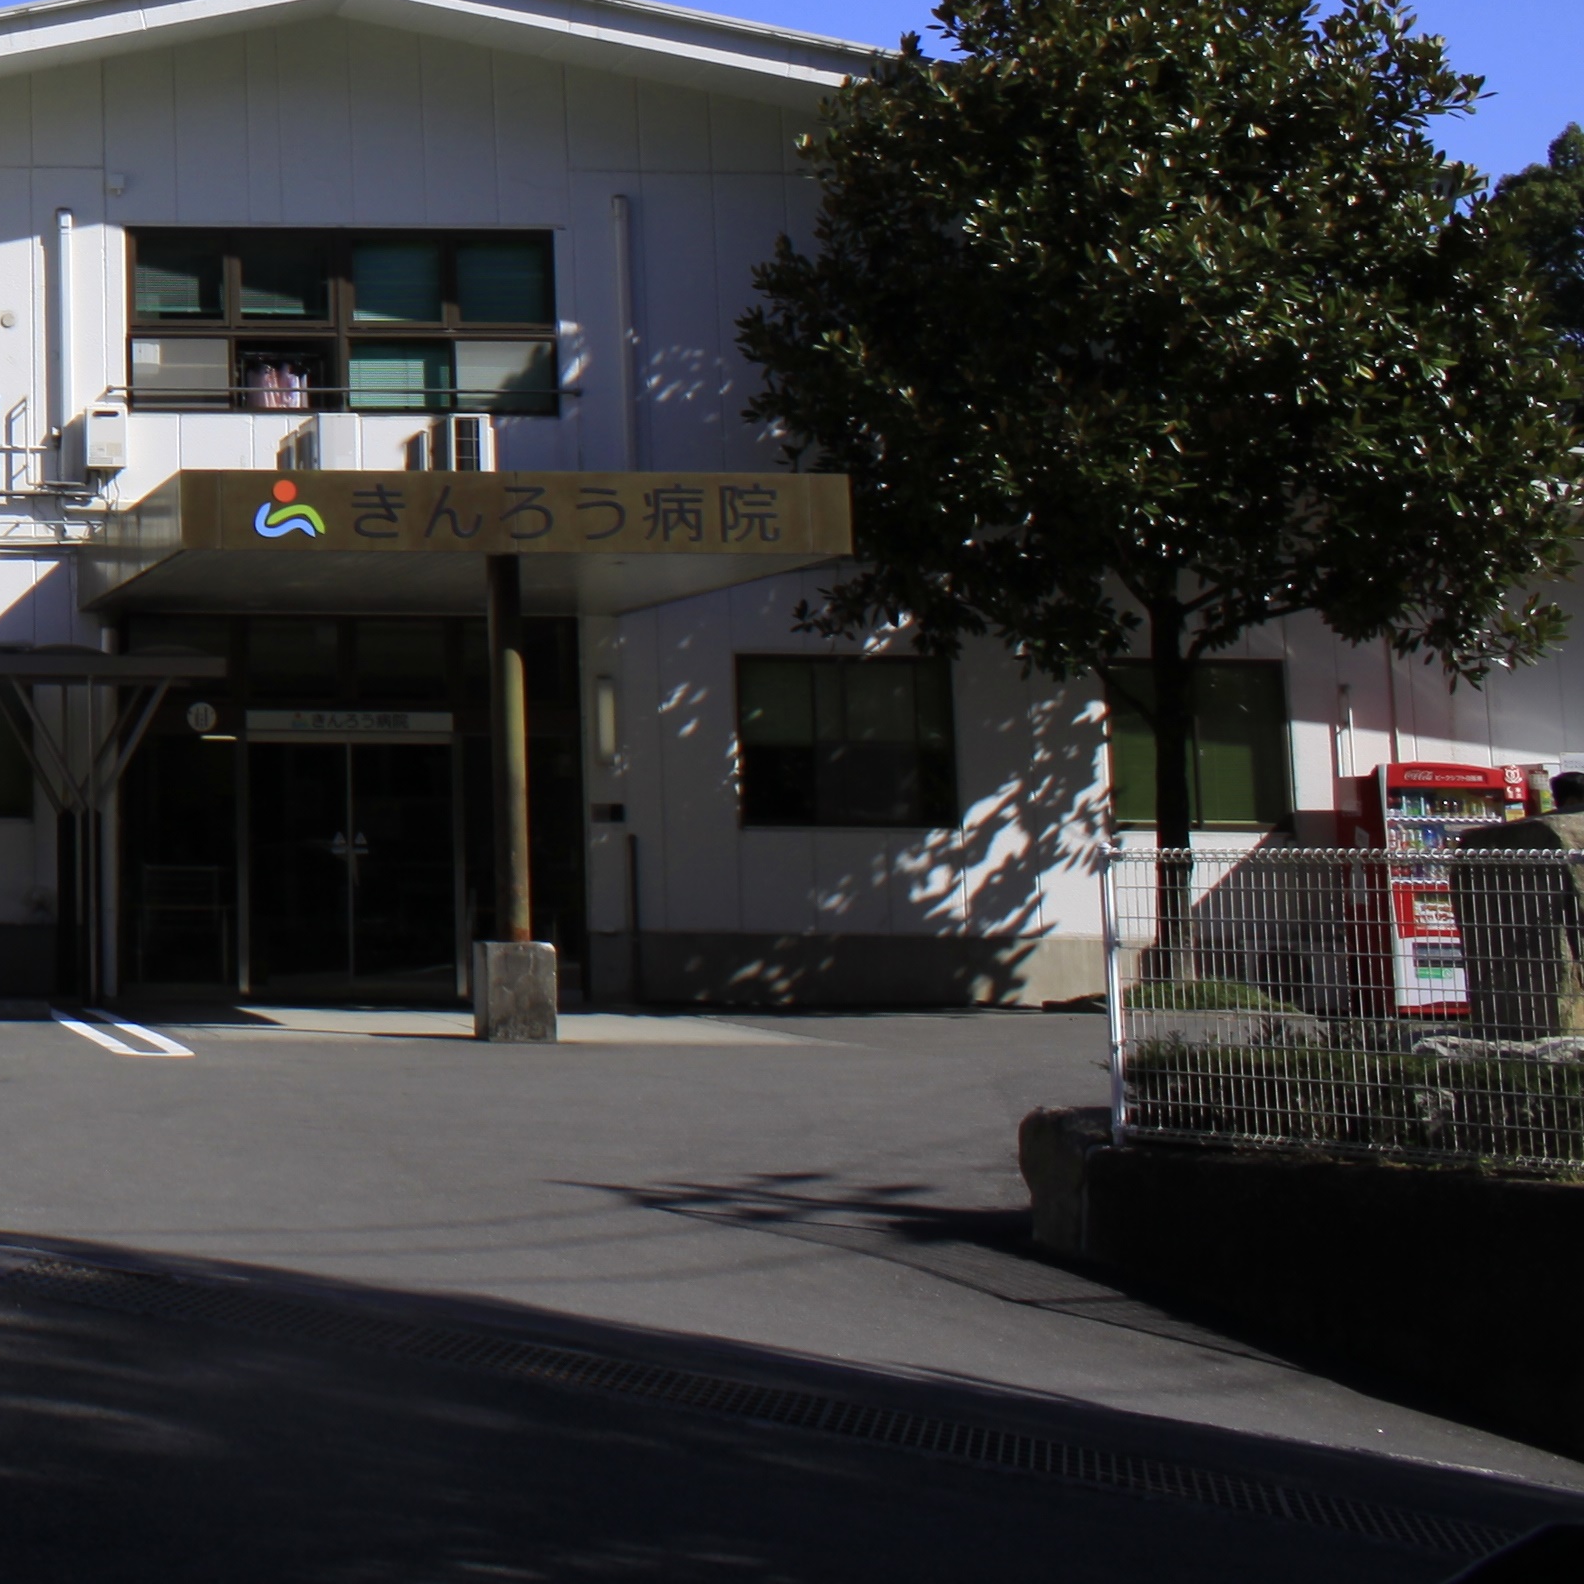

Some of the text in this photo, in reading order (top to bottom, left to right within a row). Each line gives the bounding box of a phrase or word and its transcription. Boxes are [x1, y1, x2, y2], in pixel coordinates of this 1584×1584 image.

[351, 483, 782, 544] きんろう病院
[310, 712, 410, 730] きんろう病院
